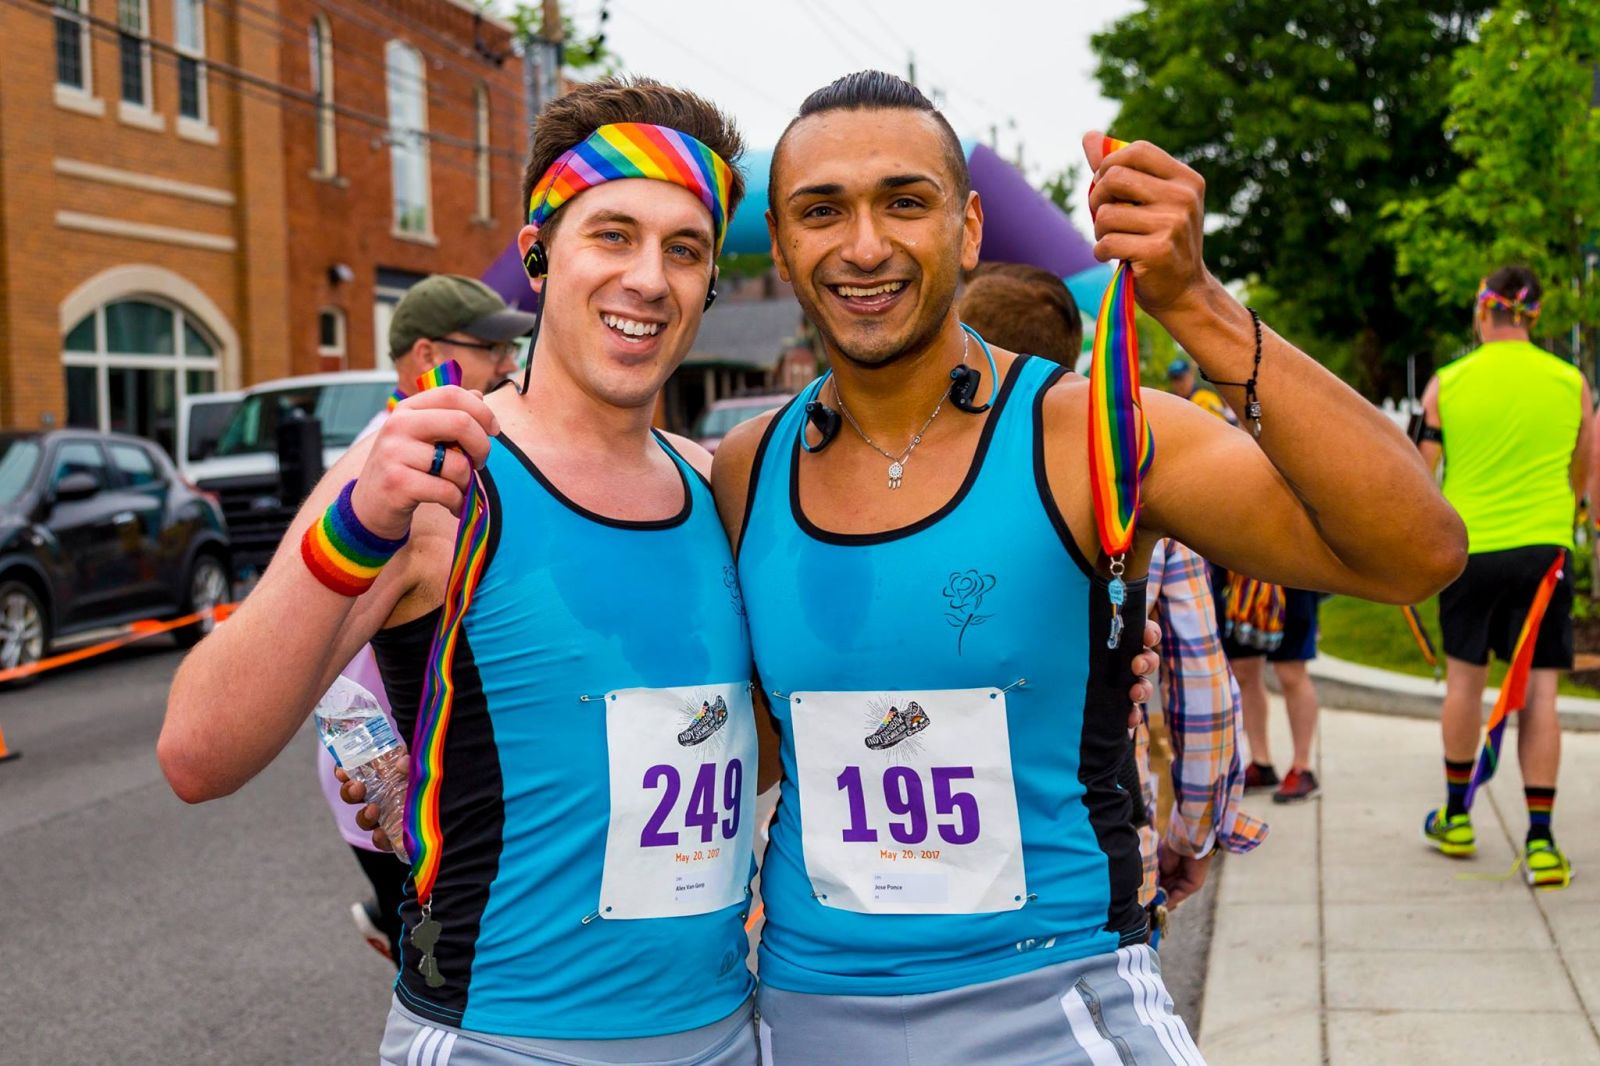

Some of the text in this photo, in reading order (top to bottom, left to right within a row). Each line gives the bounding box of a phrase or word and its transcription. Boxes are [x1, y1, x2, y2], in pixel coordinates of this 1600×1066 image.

[866, 735, 884, 745] INDY
[640, 758, 742, 848] 249
[837, 766, 980, 845] 195
[675, 852, 689, 863] May
[707, 848, 720, 859] 2017
[880, 849, 896, 861] May
[921, 850, 940, 860] 2017
